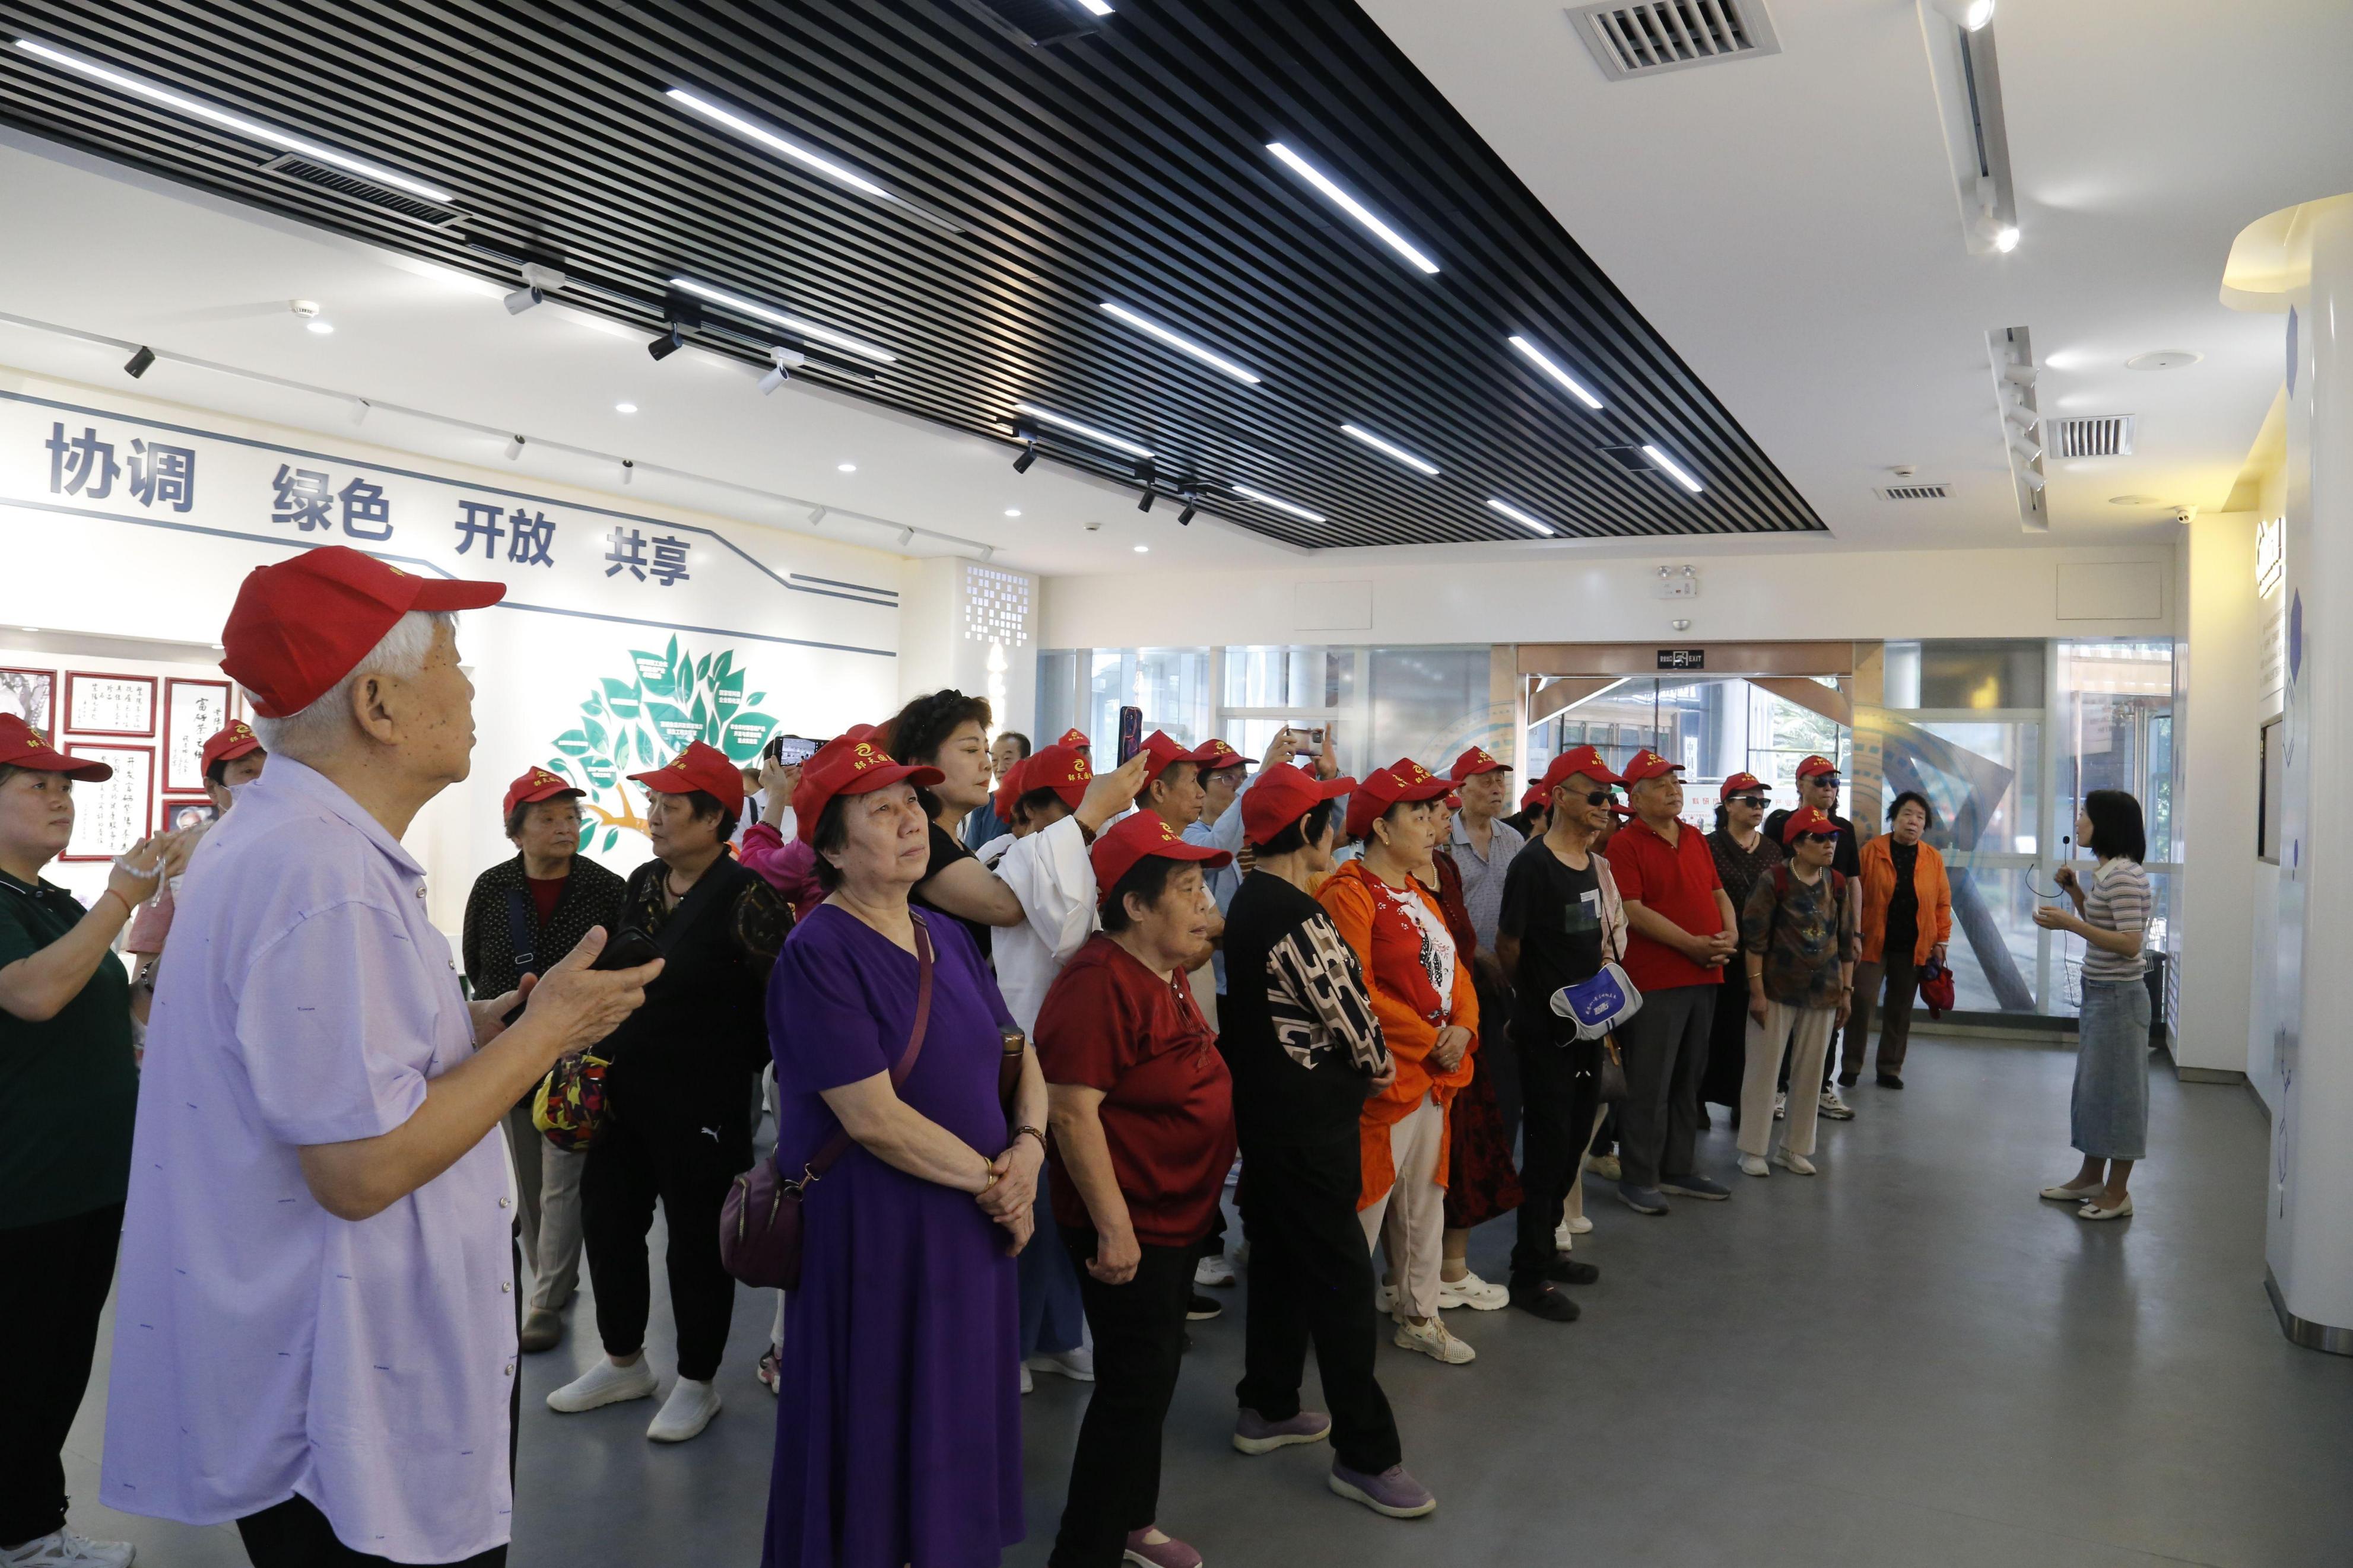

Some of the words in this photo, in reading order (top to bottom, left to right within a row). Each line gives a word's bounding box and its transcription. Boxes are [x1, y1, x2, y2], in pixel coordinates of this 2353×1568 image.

[45, 421, 196, 513] 协调
[271, 463, 394, 541] 绿色
[455, 500, 556, 568] 开放
[605, 526, 691, 587] 共享
